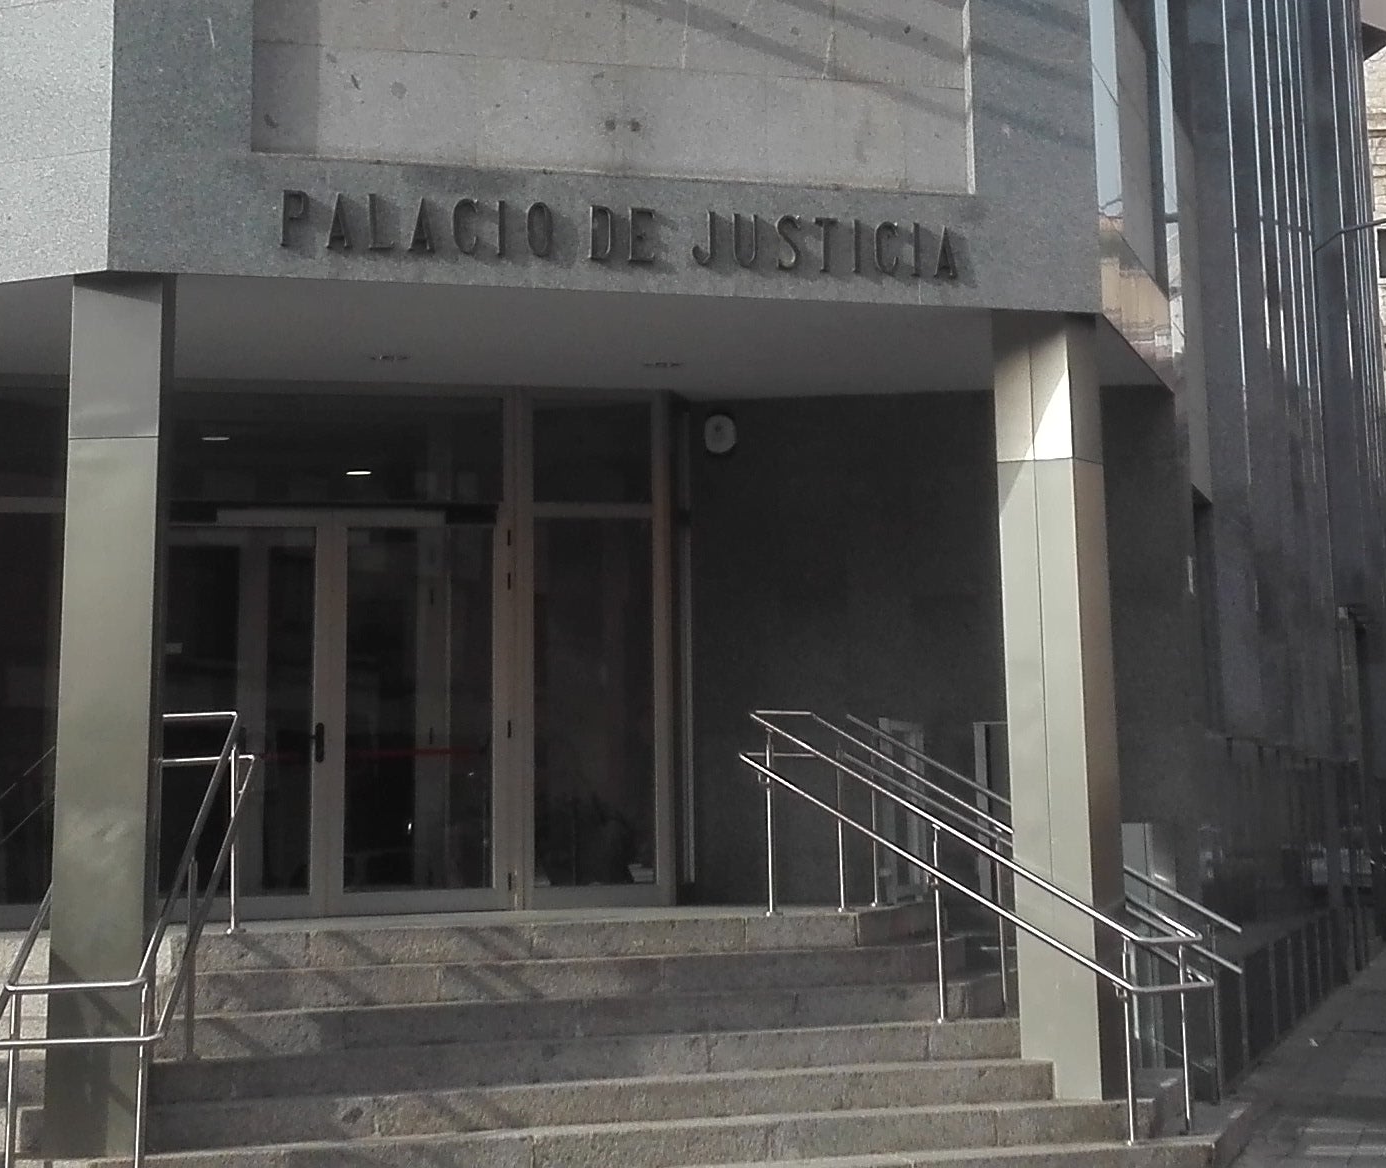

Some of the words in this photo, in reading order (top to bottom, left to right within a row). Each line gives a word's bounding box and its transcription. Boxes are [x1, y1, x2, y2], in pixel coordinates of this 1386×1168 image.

[279, 189, 553, 258] PALACIO
[588, 204, 655, 261] DE
[692, 209, 957, 278] JUSTICIA
